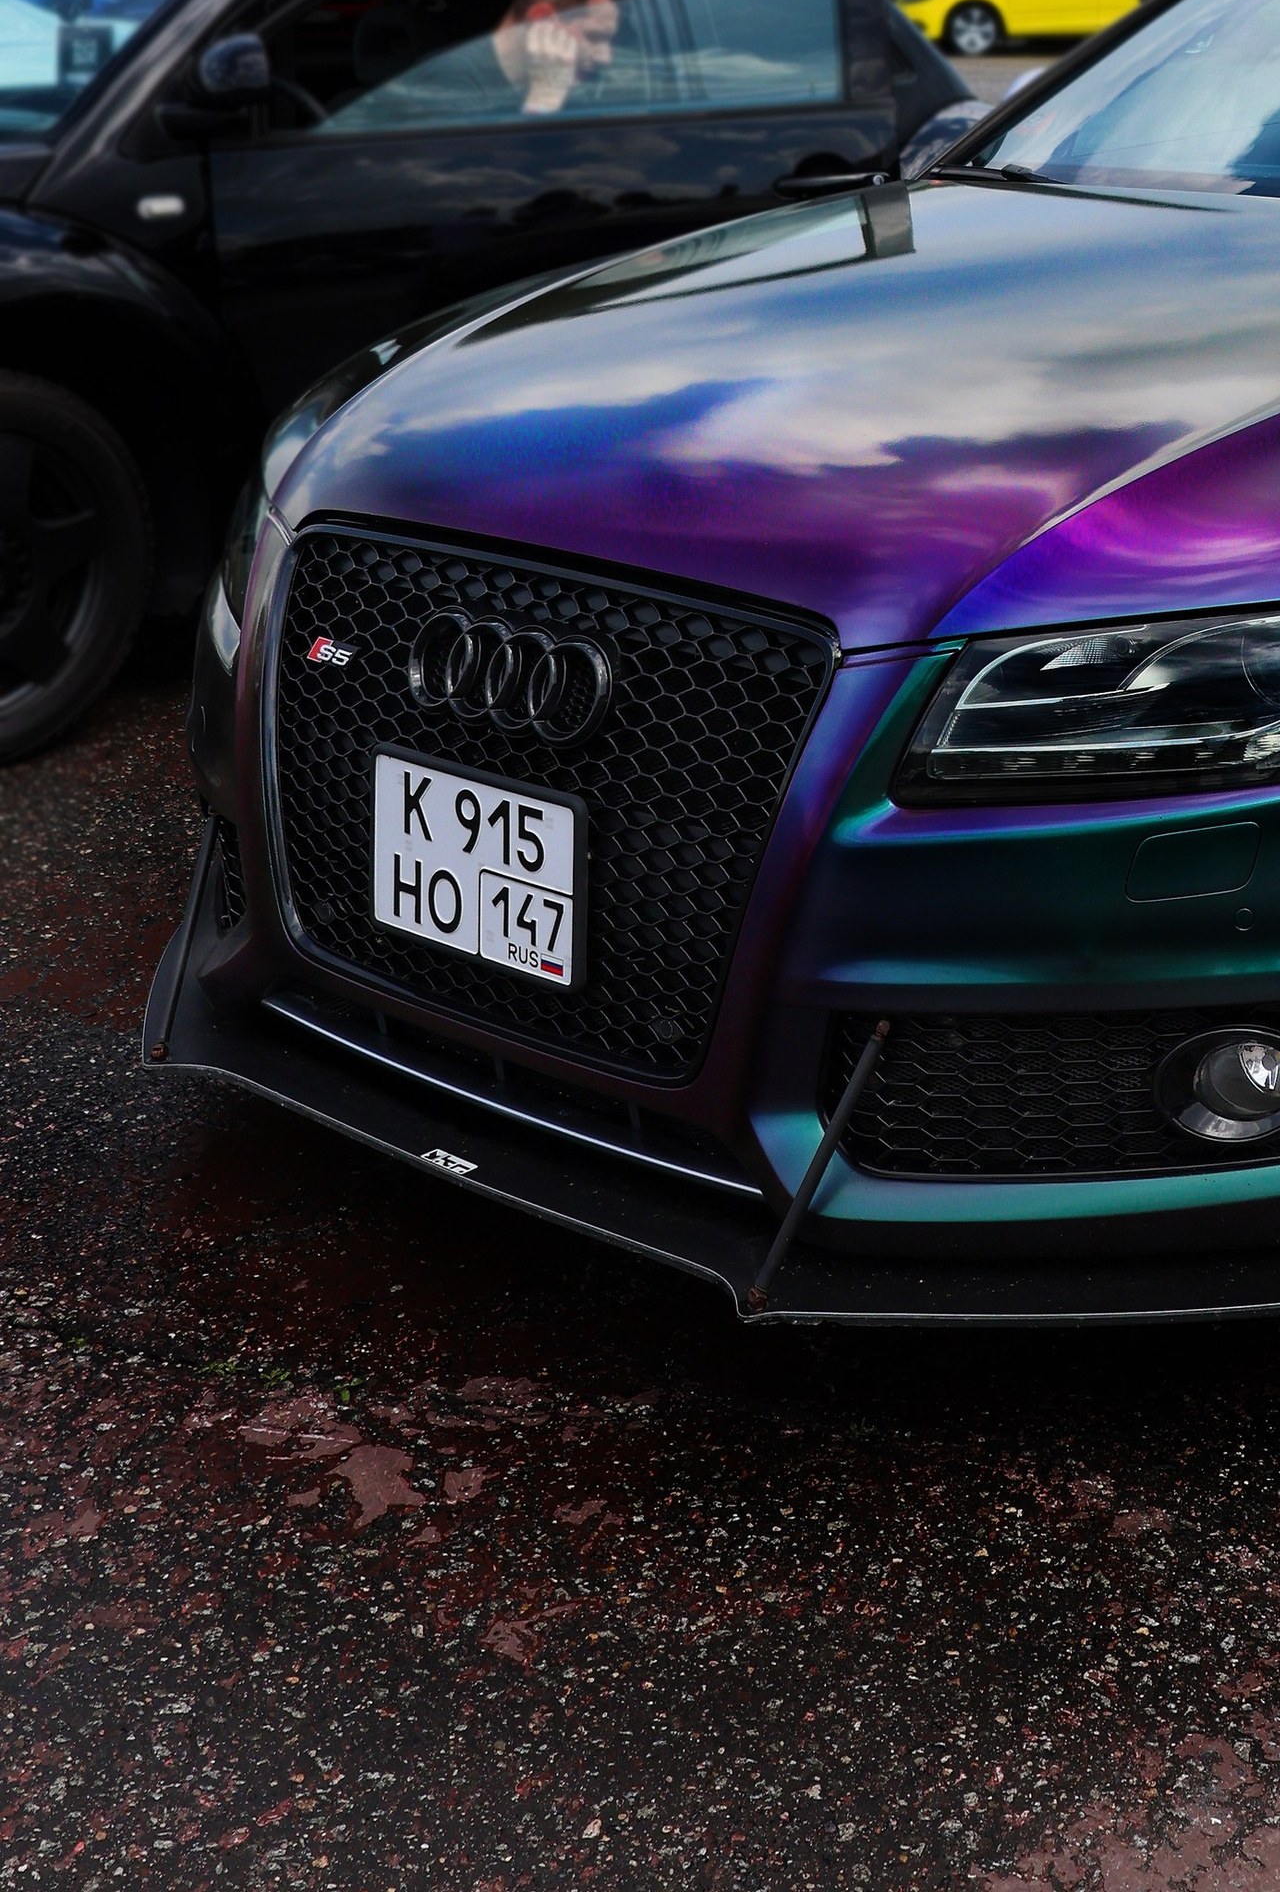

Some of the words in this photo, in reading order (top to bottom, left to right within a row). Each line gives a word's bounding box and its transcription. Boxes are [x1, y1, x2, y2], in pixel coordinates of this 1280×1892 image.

[317, 644, 353, 667] S5
[455, 788, 545, 872] 915
[491, 886, 564, 952] 147
[507, 942, 538, 968] RUS
